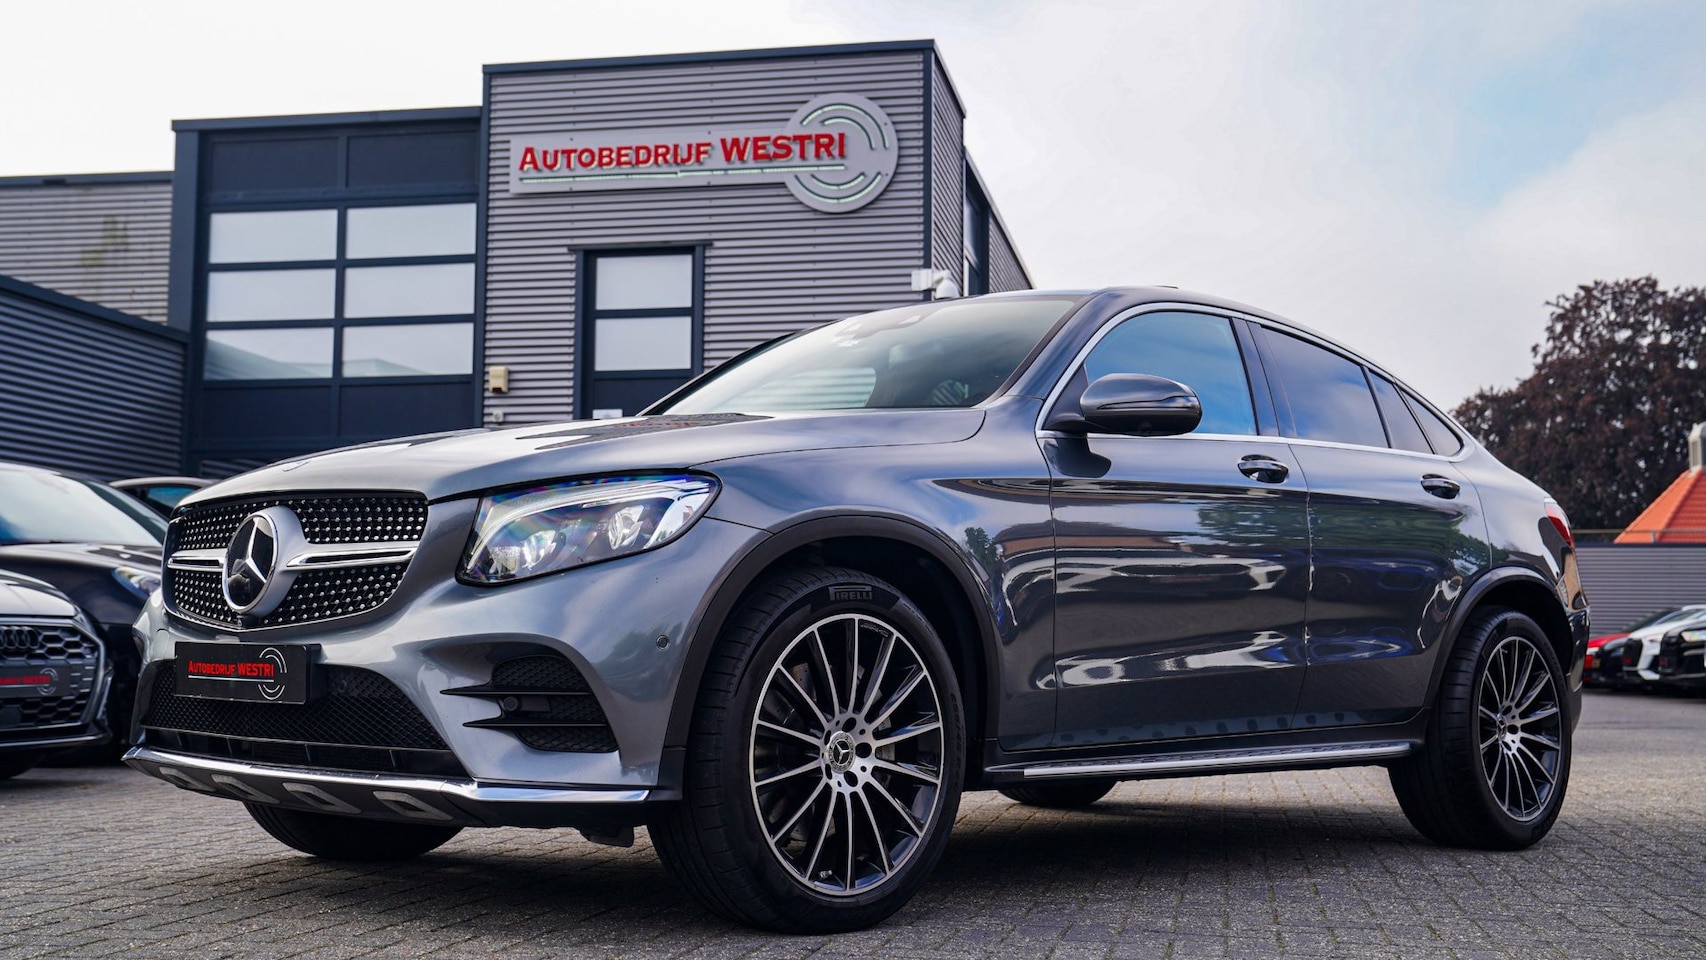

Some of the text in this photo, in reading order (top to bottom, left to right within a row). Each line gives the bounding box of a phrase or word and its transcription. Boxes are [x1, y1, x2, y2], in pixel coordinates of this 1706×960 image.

[519, 132, 846, 172] AUTOBEDRIJF WESTRI
[828, 585, 873, 601] PIRELLI
[188, 660, 275, 677] AUTOBEDRIJF WESTRI
